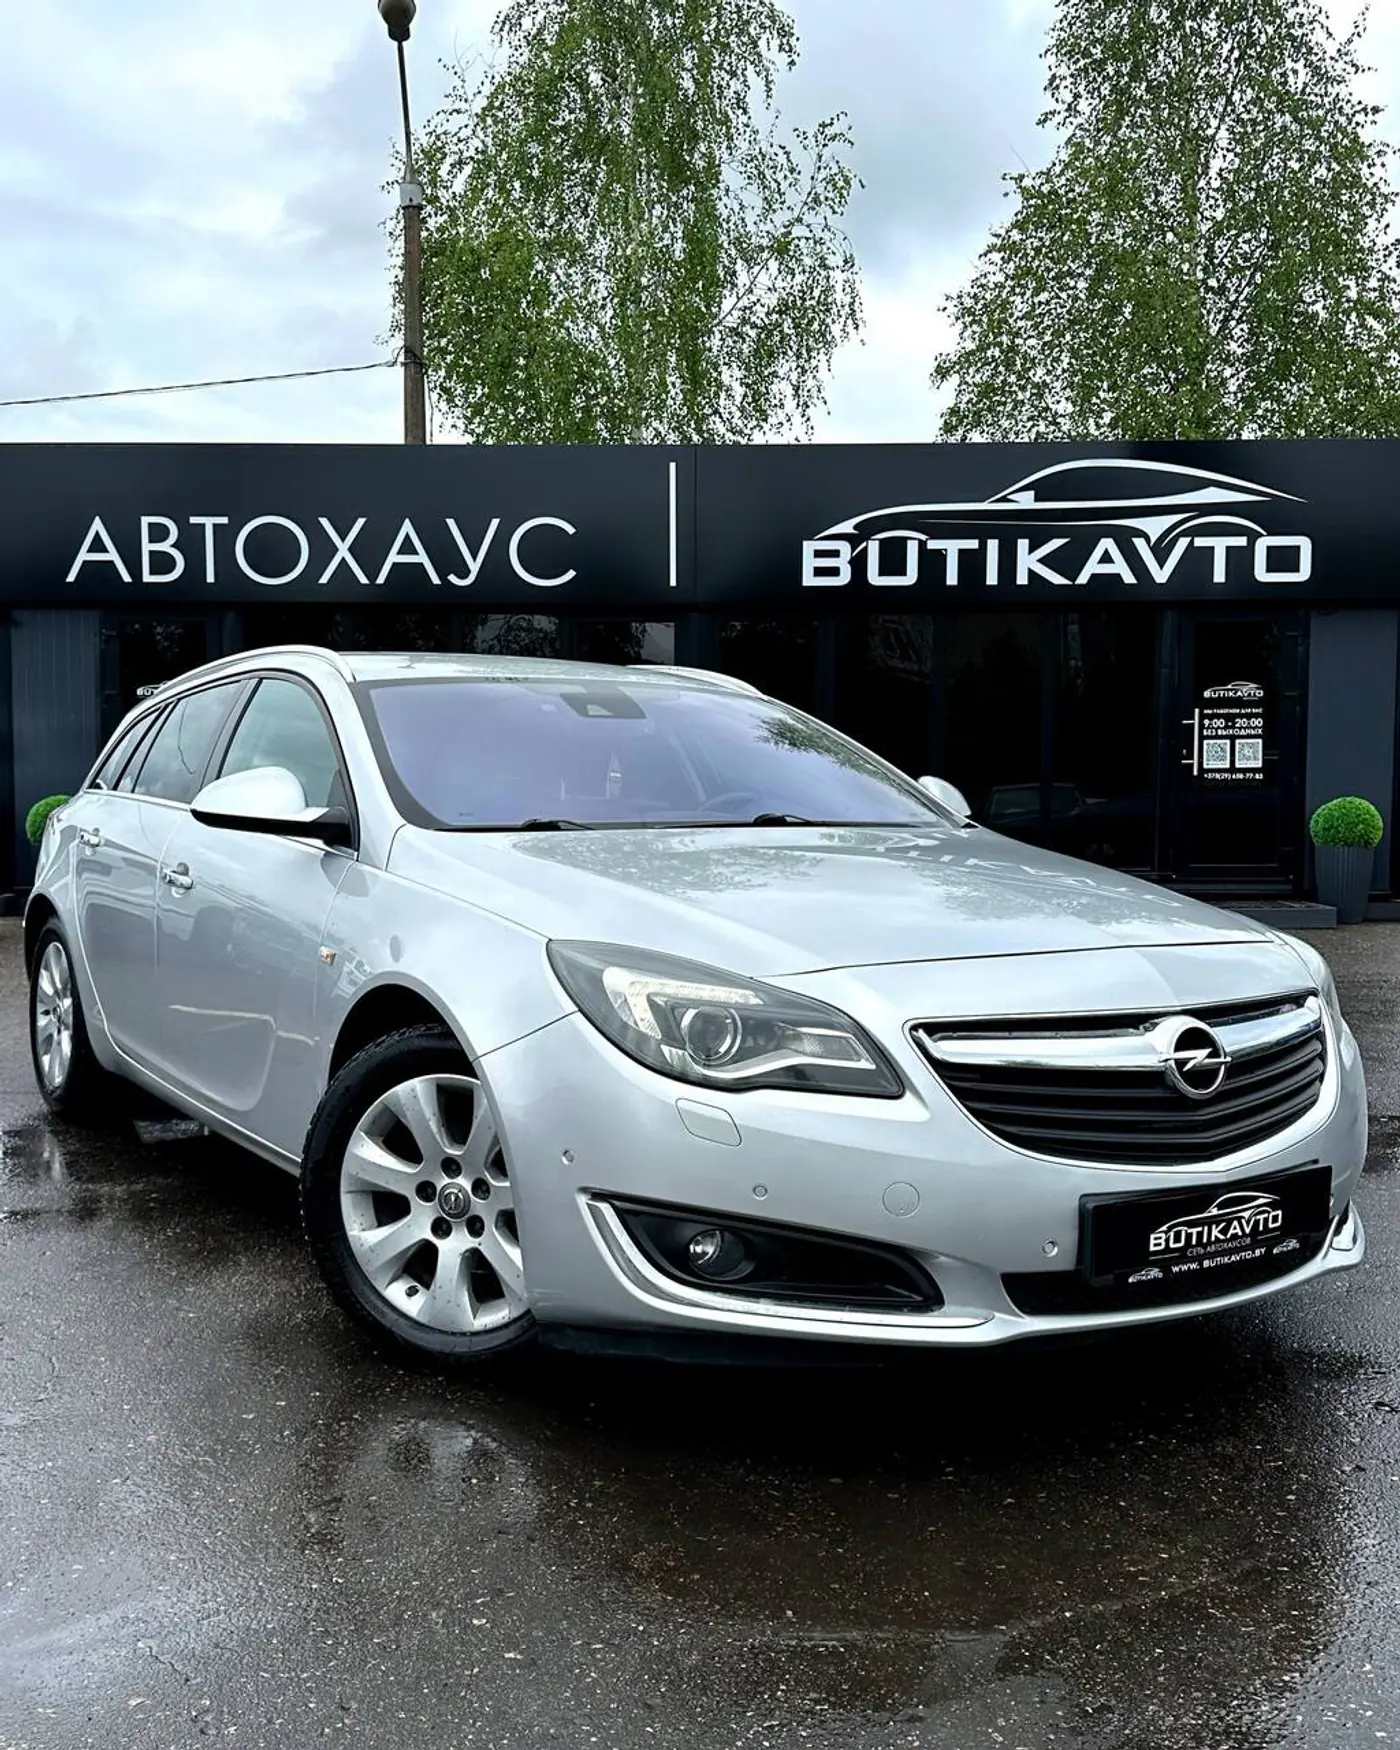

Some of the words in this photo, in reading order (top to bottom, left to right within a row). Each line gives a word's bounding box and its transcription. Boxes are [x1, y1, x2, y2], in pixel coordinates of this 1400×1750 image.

[66, 515, 578, 587] АВТОХАУС
[802, 534, 1313, 587] BUTIKAVTO
[1203, 690, 1264, 698] BUTIKAVTO
[1203, 718, 1225, 728] 9:00
[1234, 717, 1263, 728] 20:00
[1217, 728, 1263, 736] ВЫХОДНЫХ
[1149, 1210, 1283, 1252] BUTIKAVTO
[1187, 1246, 1205, 1257] СЕТЬ
[1206, 1237, 1251, 1253] АВТОХАУСОВ
[1203, 1247, 1266, 1269] BUTIKAVTO.BY
